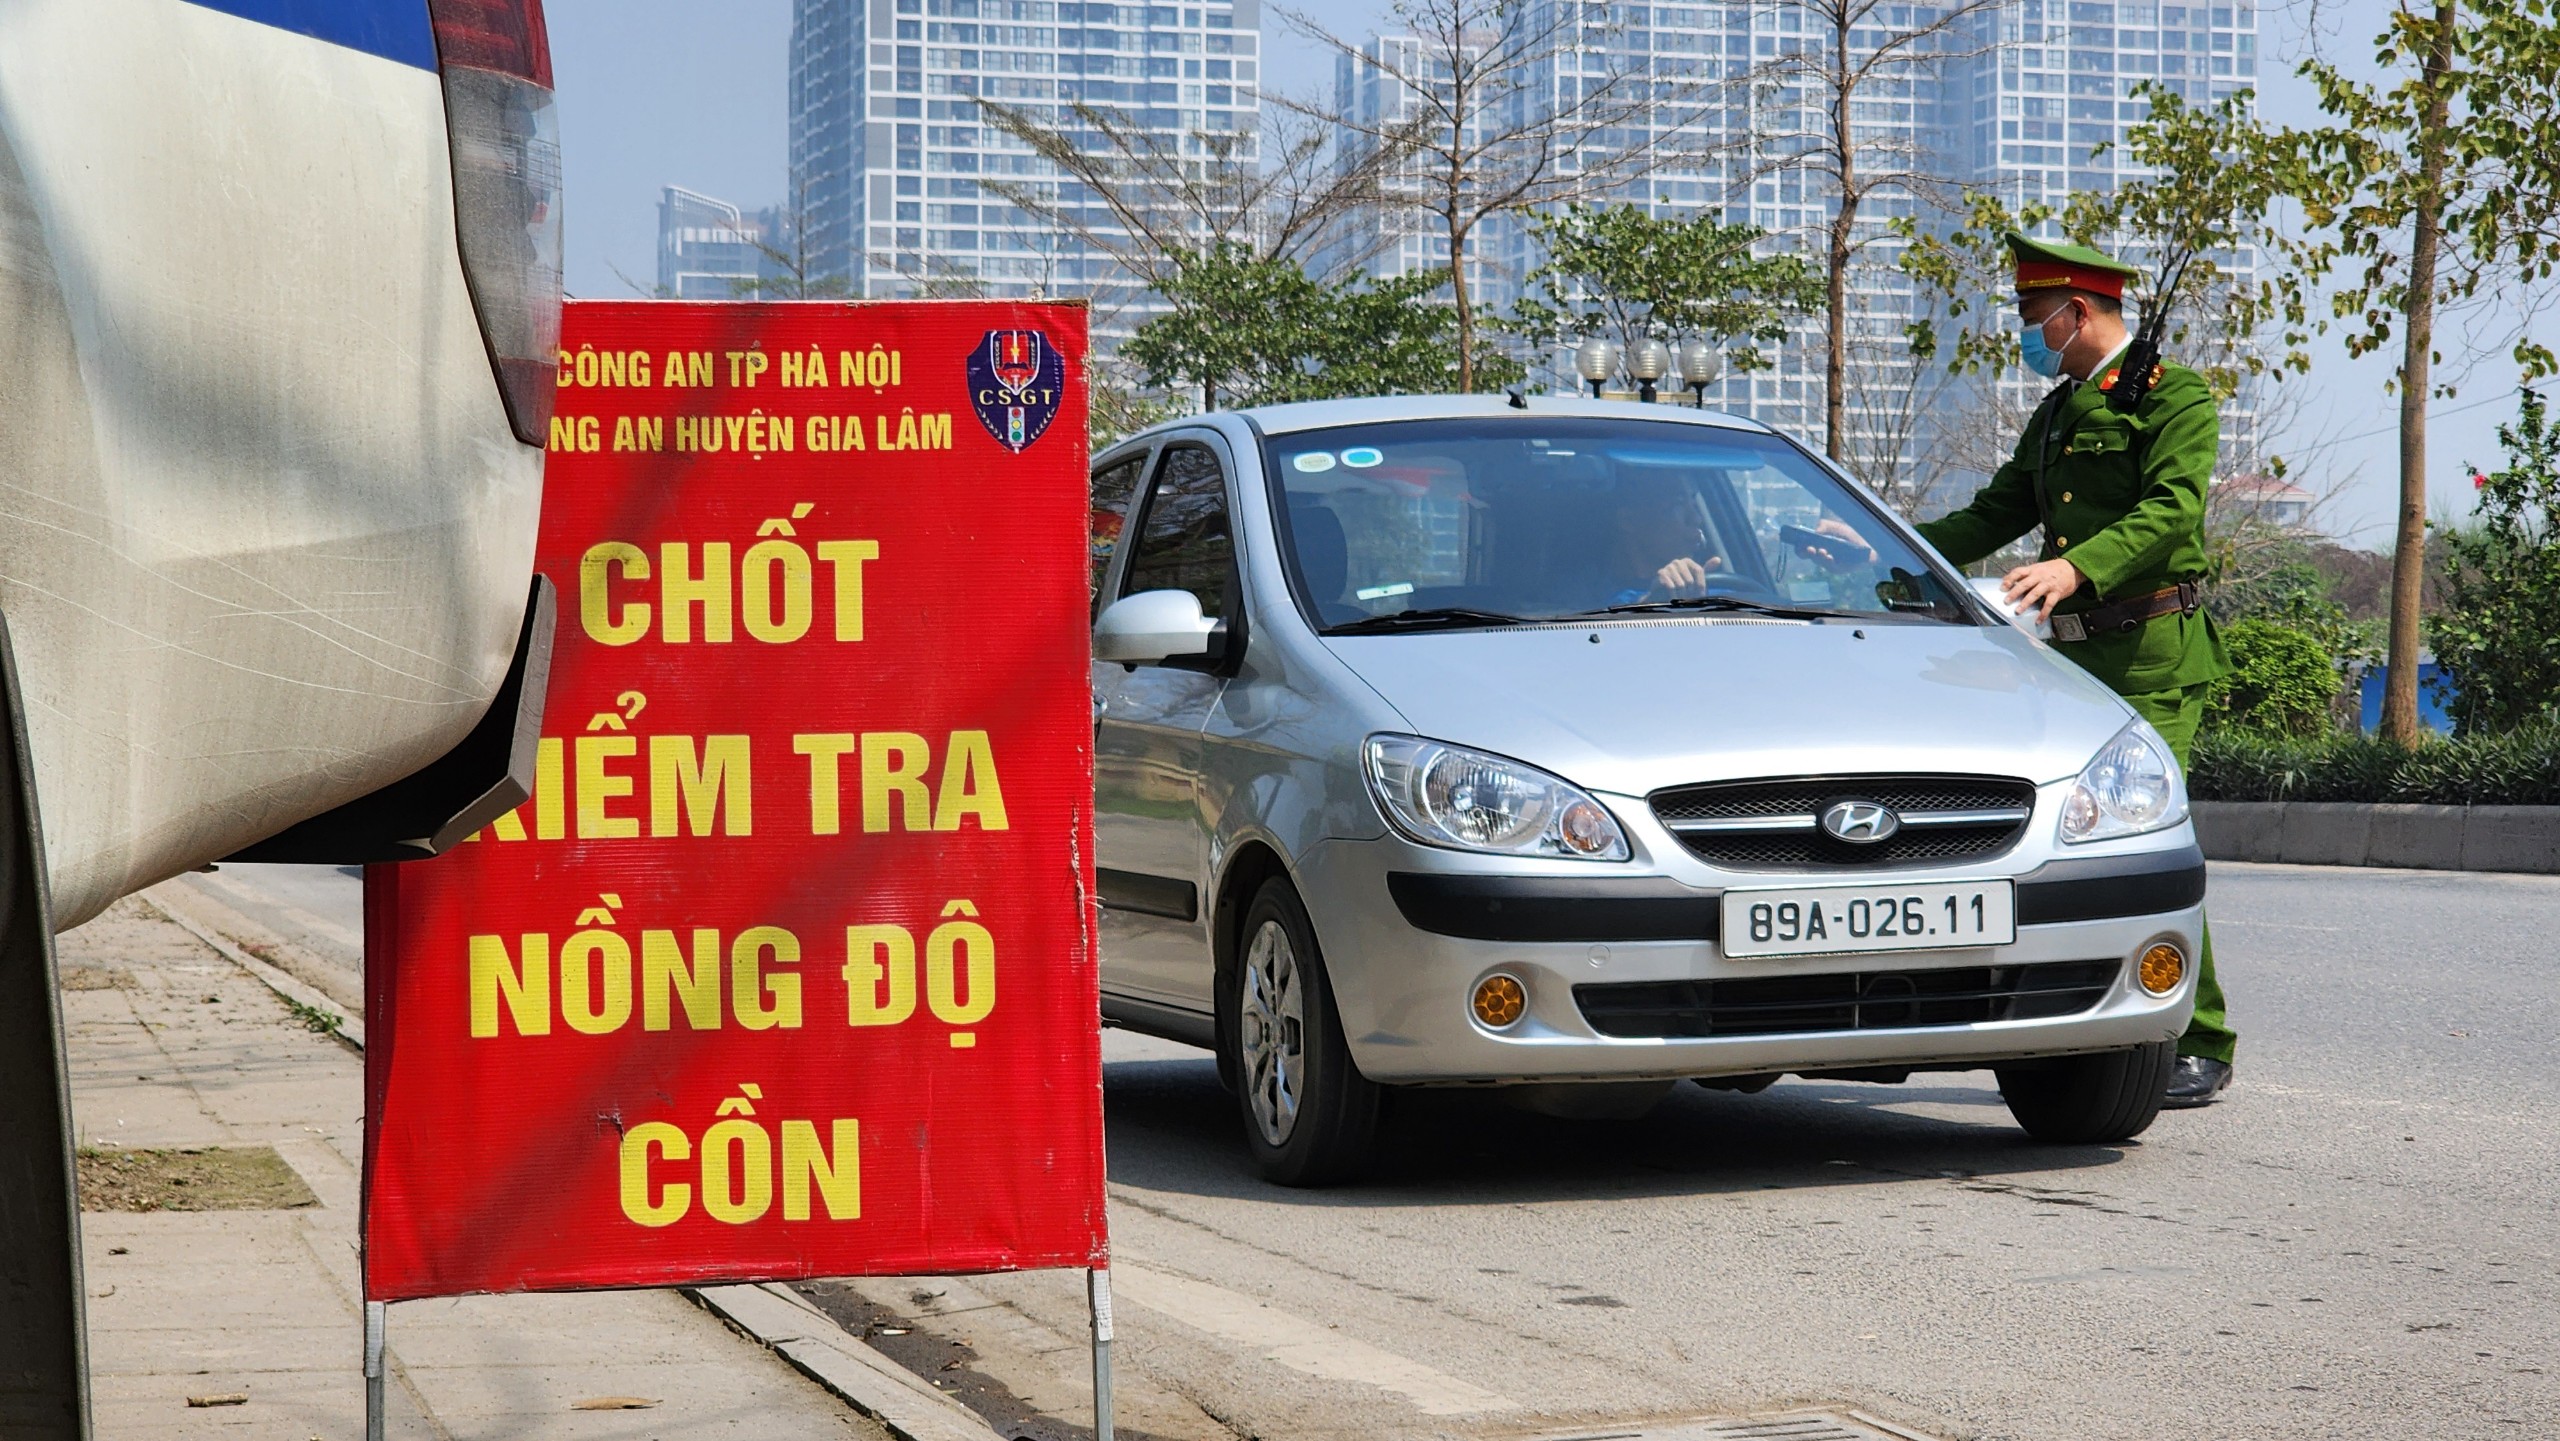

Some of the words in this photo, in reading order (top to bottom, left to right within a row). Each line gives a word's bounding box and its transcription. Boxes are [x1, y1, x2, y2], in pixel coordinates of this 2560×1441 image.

[556, 343, 651, 388] CÔNG
[663, 351, 714, 388] AN
[725, 350, 770, 388] TP
[780, 343, 829, 388] HÀ
[839, 343, 902, 396] NỘI
[979, 388, 1054, 406] CSGT
[545, 415, 601, 453] NG
[612, 415, 663, 452] AN
[675, 408, 795, 460] HUYỆN
[806, 414, 867, 453] GIA
[877, 407, 953, 451] LÂM
[578, 502, 880, 647] CHỐT
[462, 690, 753, 842] IỂM
[792, 729, 1010, 835] TRA
[1750, 893, 1984, 943] 89A-026.11
[469, 892, 803, 1039] NỒNG
[841, 898, 997, 1049] ĐỘ
[619, 1083, 862, 1229] CỒN
